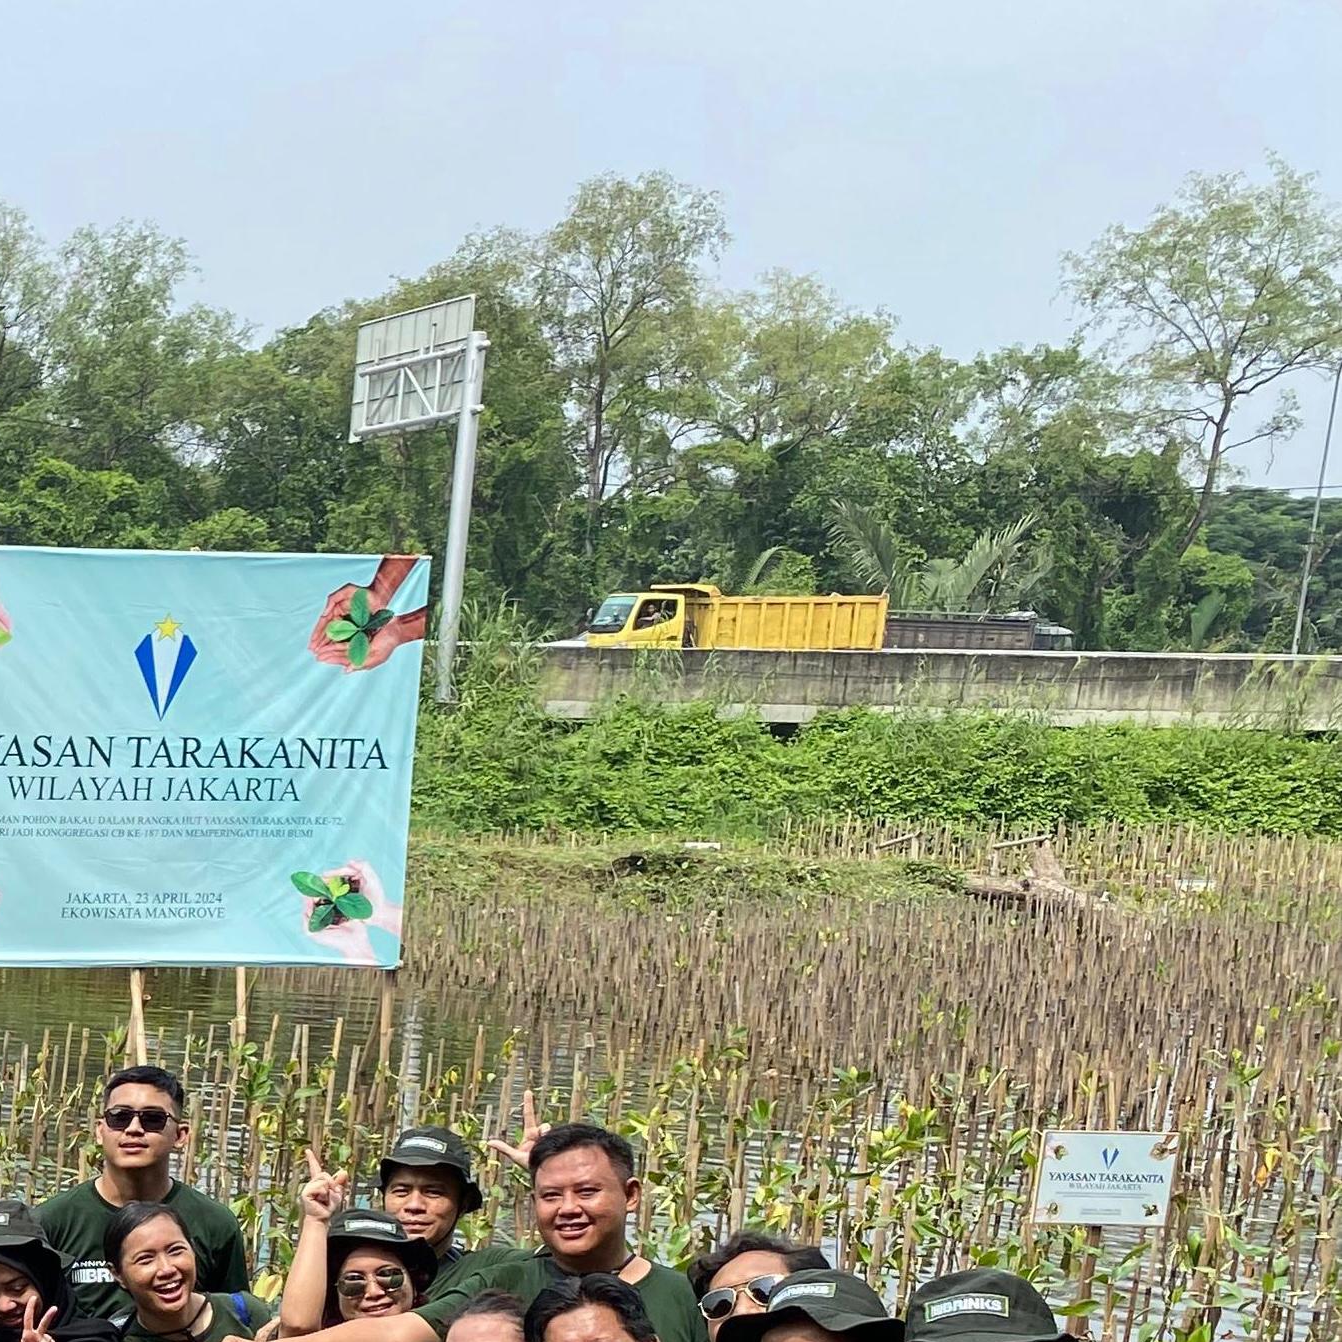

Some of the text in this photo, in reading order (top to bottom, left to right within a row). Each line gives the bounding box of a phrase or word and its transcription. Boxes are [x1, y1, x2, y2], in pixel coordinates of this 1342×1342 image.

[126, 736, 390, 771] TARAKANITA
[6, 776, 302, 802] WILAYAH JAKARTA
[22, 815, 58, 825] POHON
[59, 815, 96, 825] BAKAU
[98, 816, 136, 825] DALAM
[137, 816, 180, 825] RANGKA
[181, 816, 203, 825] HUT
[204, 816, 249, 825] YAYASAN
[250, 816, 313, 825] TARAKANITA
[11, 828, 34, 838] JADI
[111, 829, 125, 838] CB
[161, 829, 183, 838] DAN
[261, 829, 286, 838] HARI
[287, 829, 314, 839] BUMI
[65, 892, 224, 906] JAKARTA, 23 APRIL 2024
[60, 907, 226, 920] EKOWISATA MANGROVE
[1048, 1171, 1165, 1184] YAYASAN TARAKANITA
[939, 1299, 1002, 1315] BRINKS
